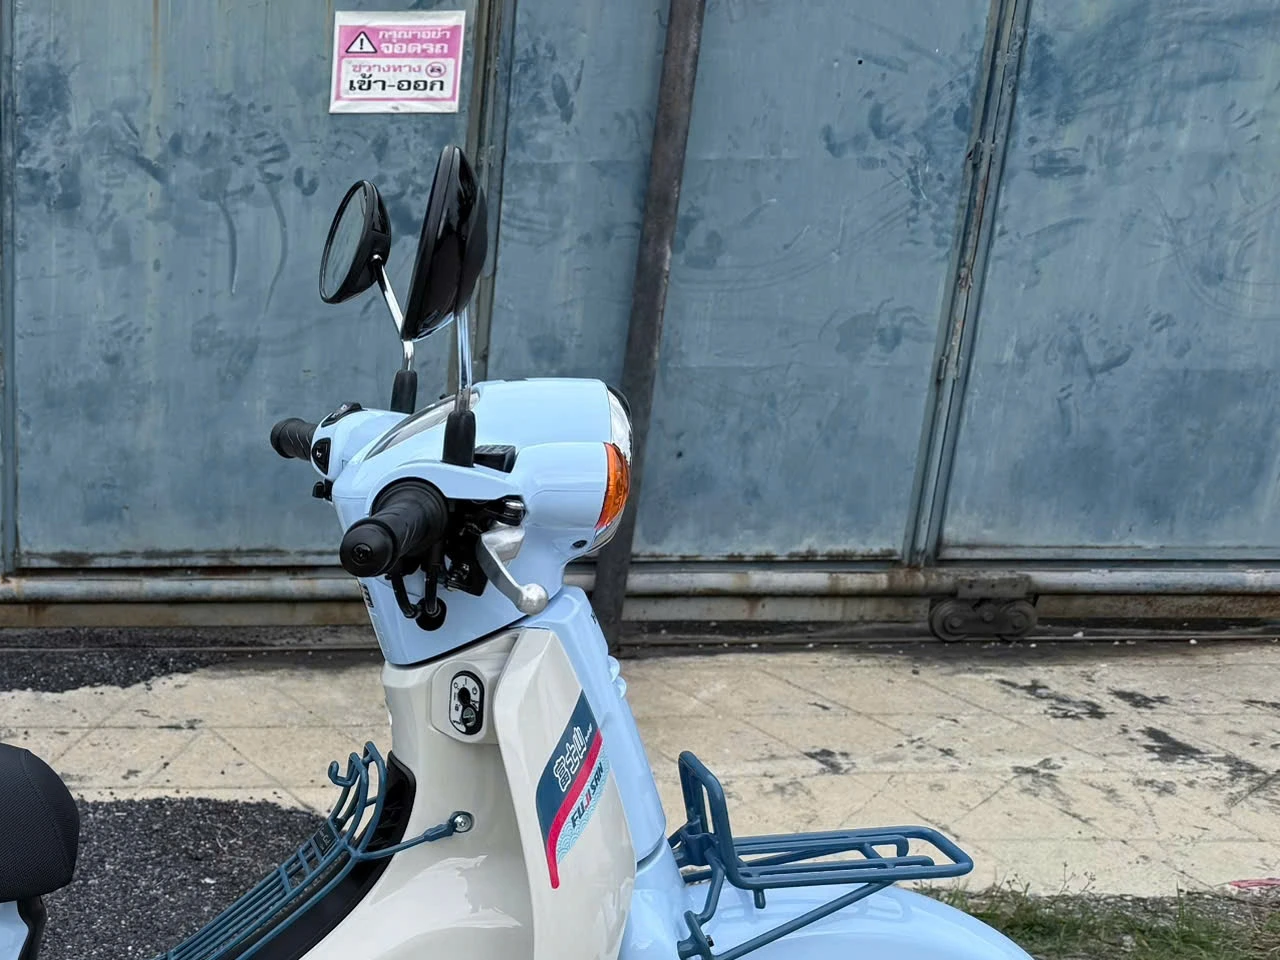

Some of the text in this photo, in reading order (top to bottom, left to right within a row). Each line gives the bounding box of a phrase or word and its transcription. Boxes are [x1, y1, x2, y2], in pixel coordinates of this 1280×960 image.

[380, 43, 449, 55] จอดรถ
[351, 62, 422, 74] ขวางทาง
[348, 73, 444, 92] เข้า-ออก
[570, 761, 604, 829] FUJISAN
